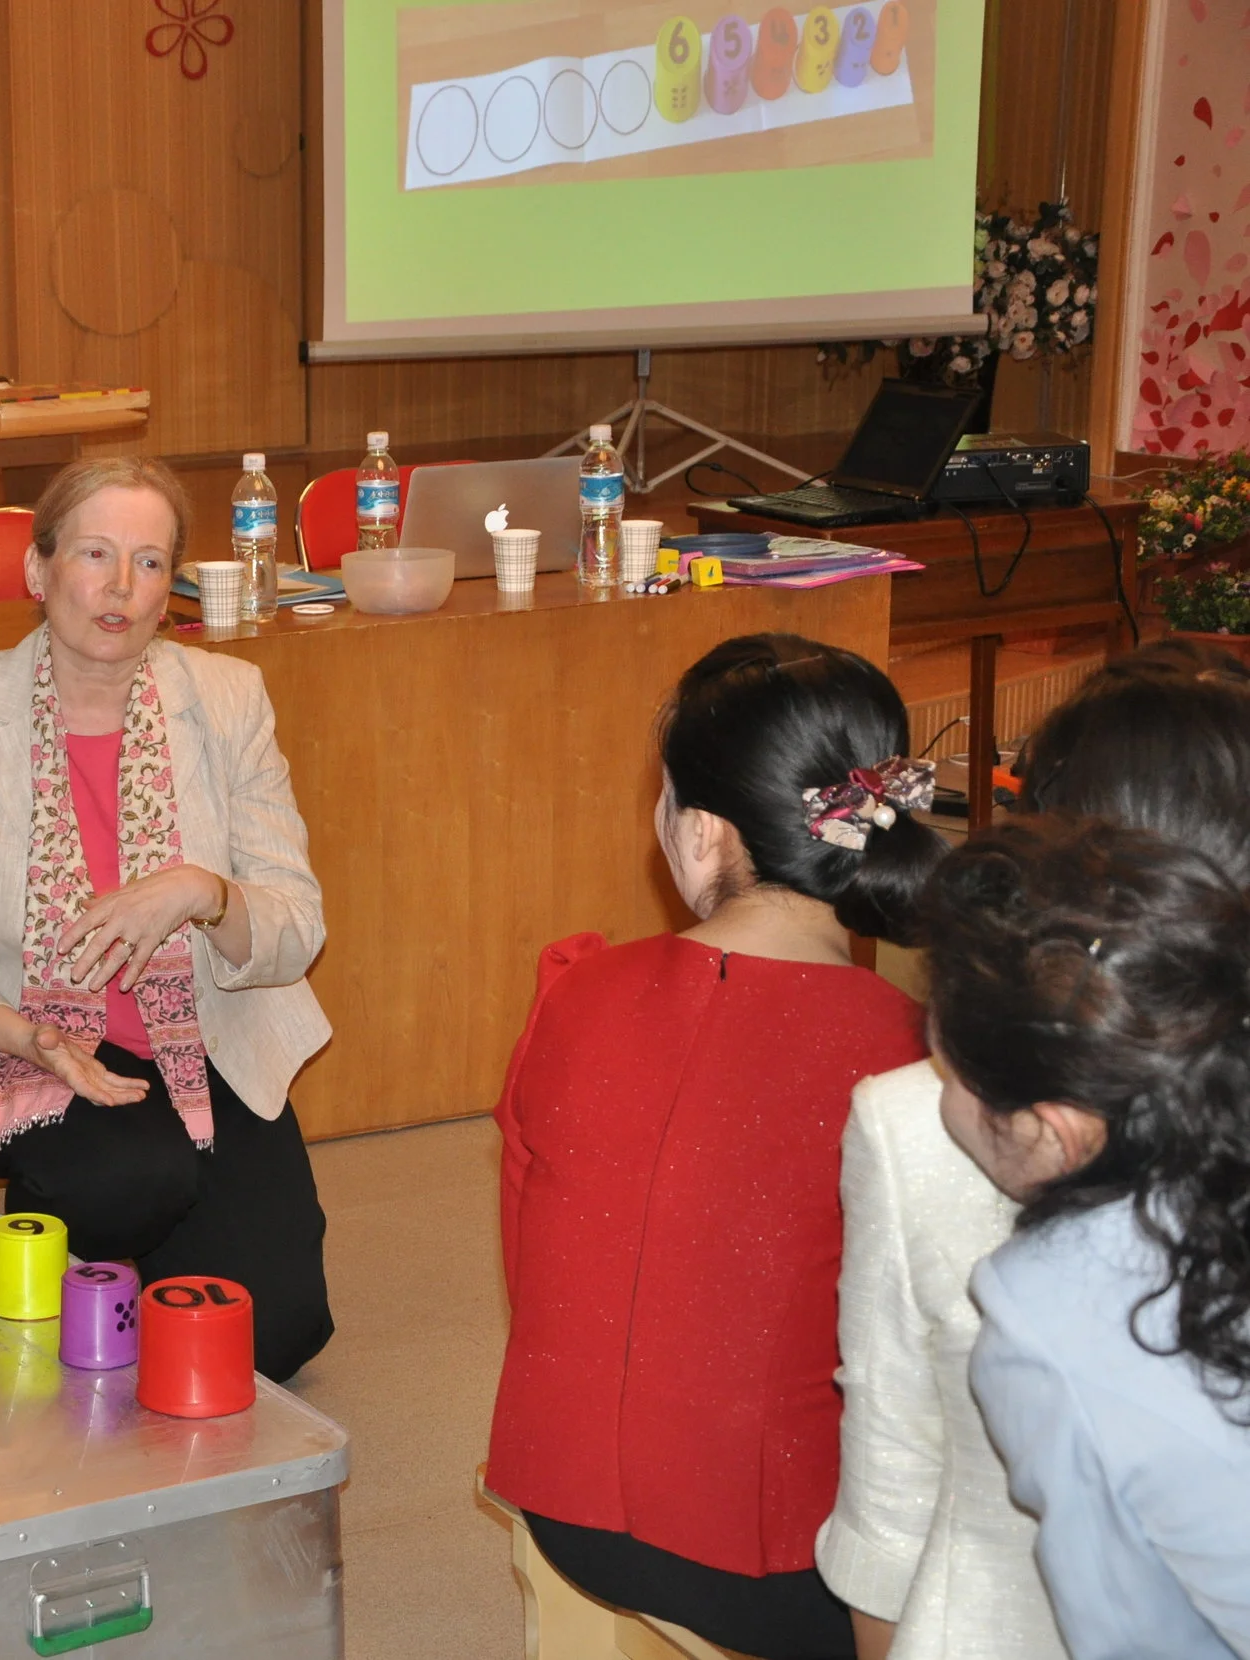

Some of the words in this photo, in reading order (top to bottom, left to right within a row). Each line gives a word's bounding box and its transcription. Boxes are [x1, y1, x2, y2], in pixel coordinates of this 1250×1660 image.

[668, 20, 690, 65] 6
[723, 21, 743, 60] 5
[770, 19, 789, 46] 4
[813, 15, 830, 46] 3
[853, 12, 871, 41] 2
[74, 1265, 119, 1283] 5
